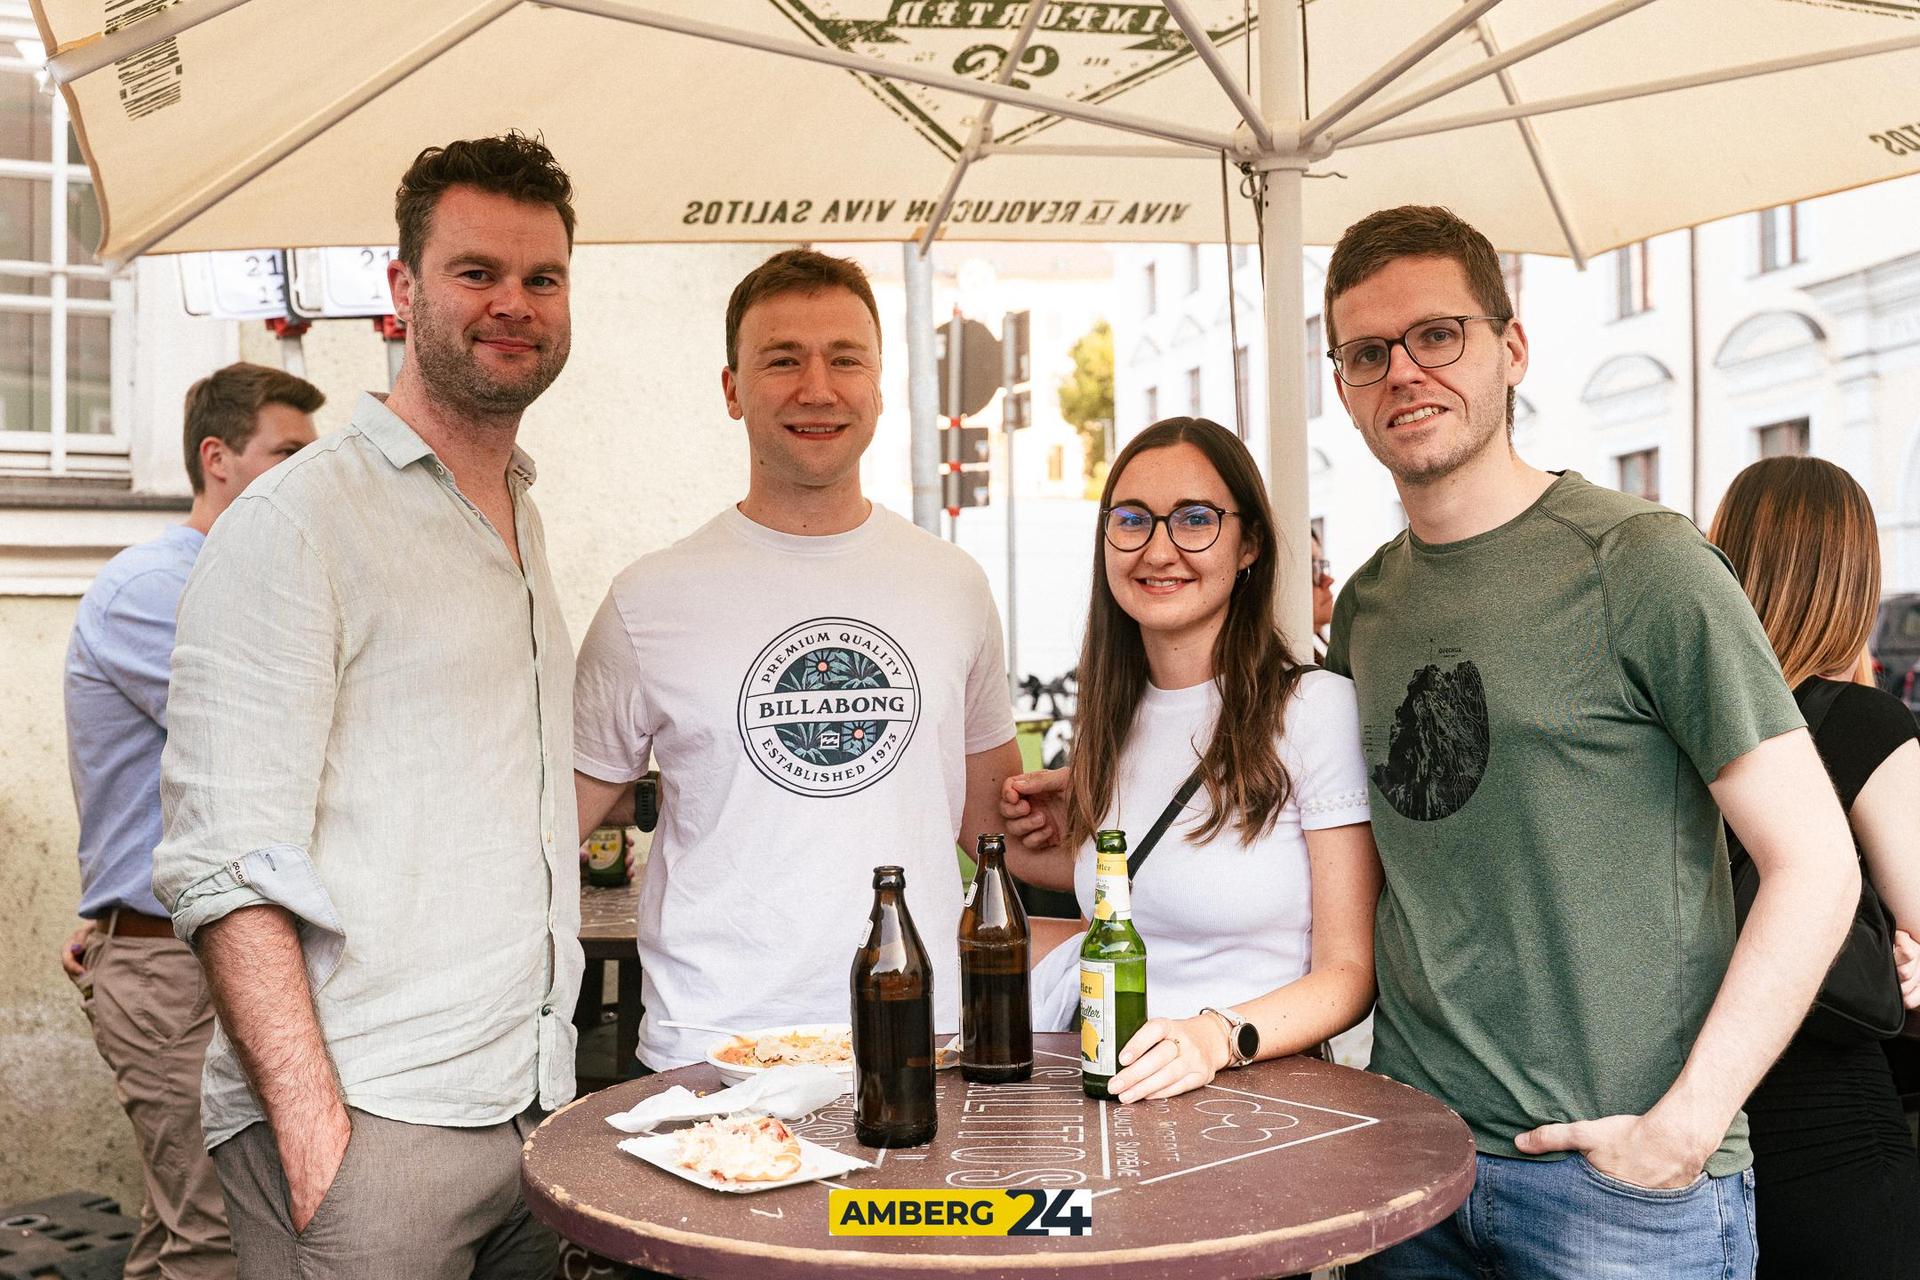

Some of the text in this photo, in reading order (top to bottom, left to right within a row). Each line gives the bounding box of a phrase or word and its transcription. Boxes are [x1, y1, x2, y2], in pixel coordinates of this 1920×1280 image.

[762, 632, 902, 684] PREMIUM QUALITY
[759, 696, 905, 719] BILLABONG
[761, 732, 897, 783] ESTABLISHED 1973
